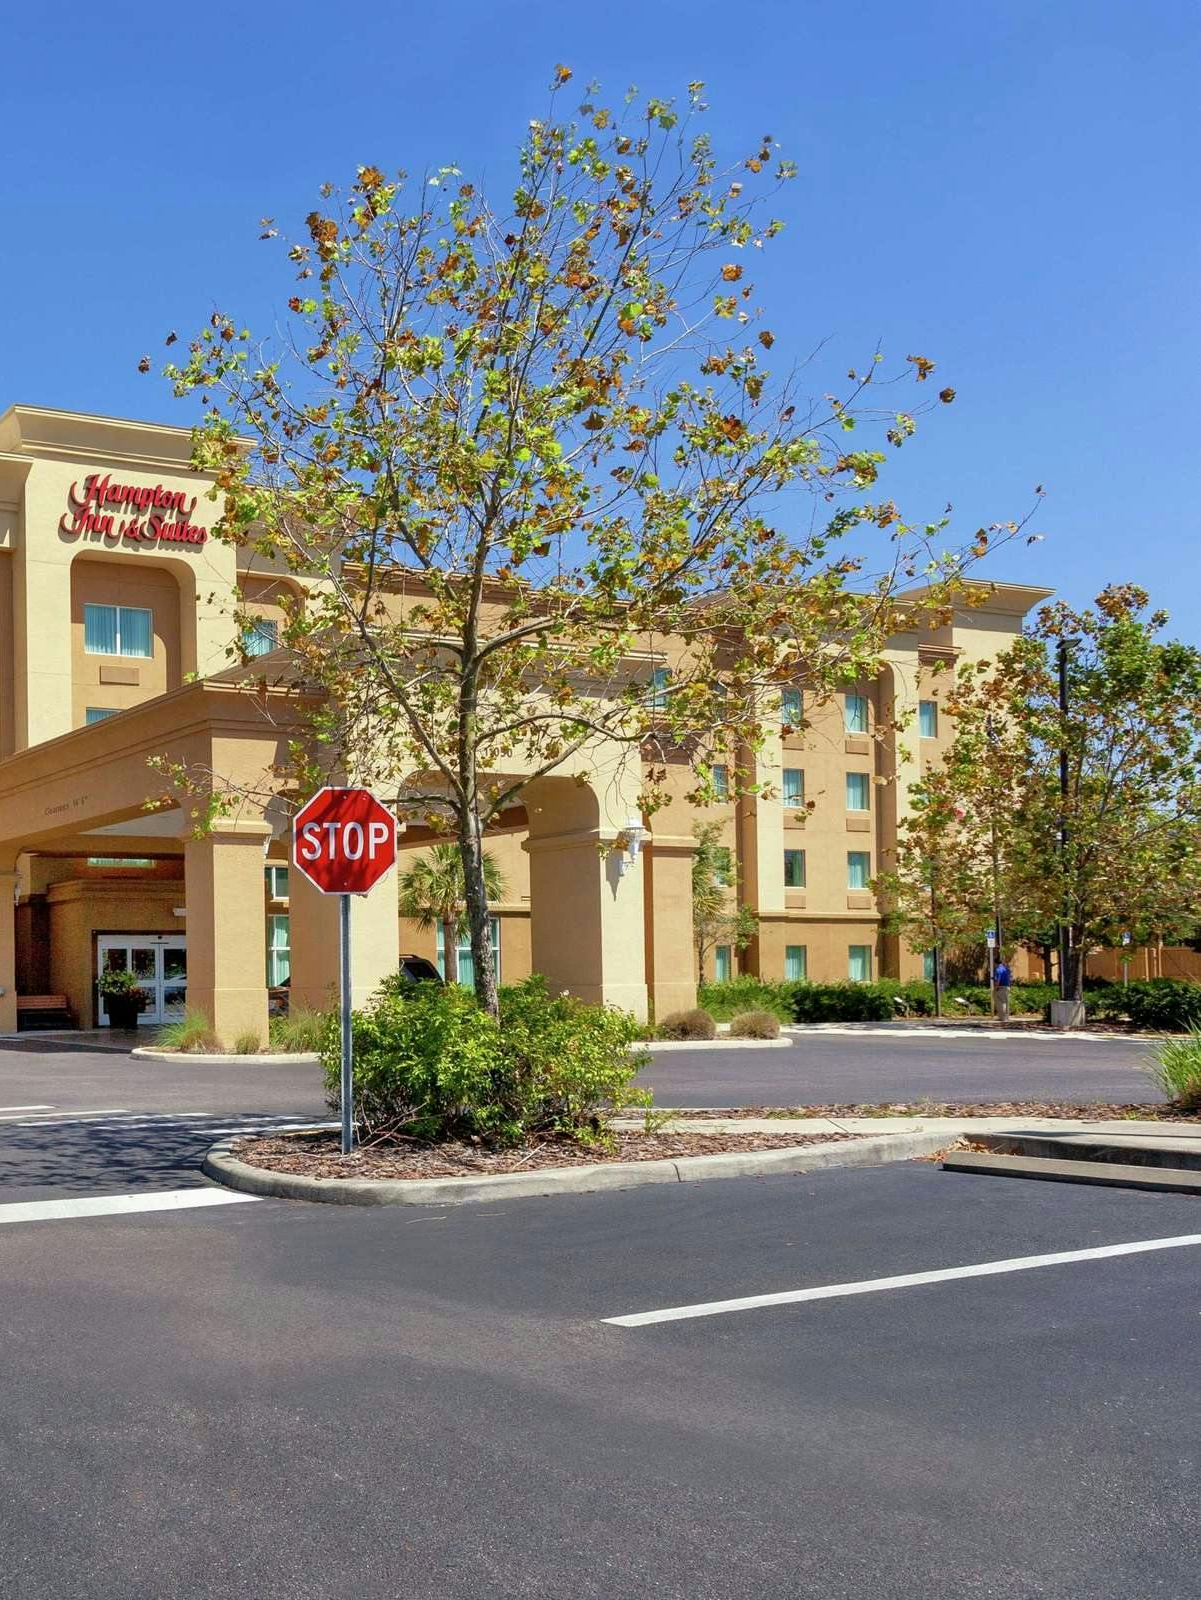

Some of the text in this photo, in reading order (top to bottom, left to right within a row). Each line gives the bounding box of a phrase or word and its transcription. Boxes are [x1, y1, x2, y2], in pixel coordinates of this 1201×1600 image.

[70, 474, 197, 515] Hampton
[60, 505, 208, 544] Inn & Suites
[301, 821, 389, 861] STOP
